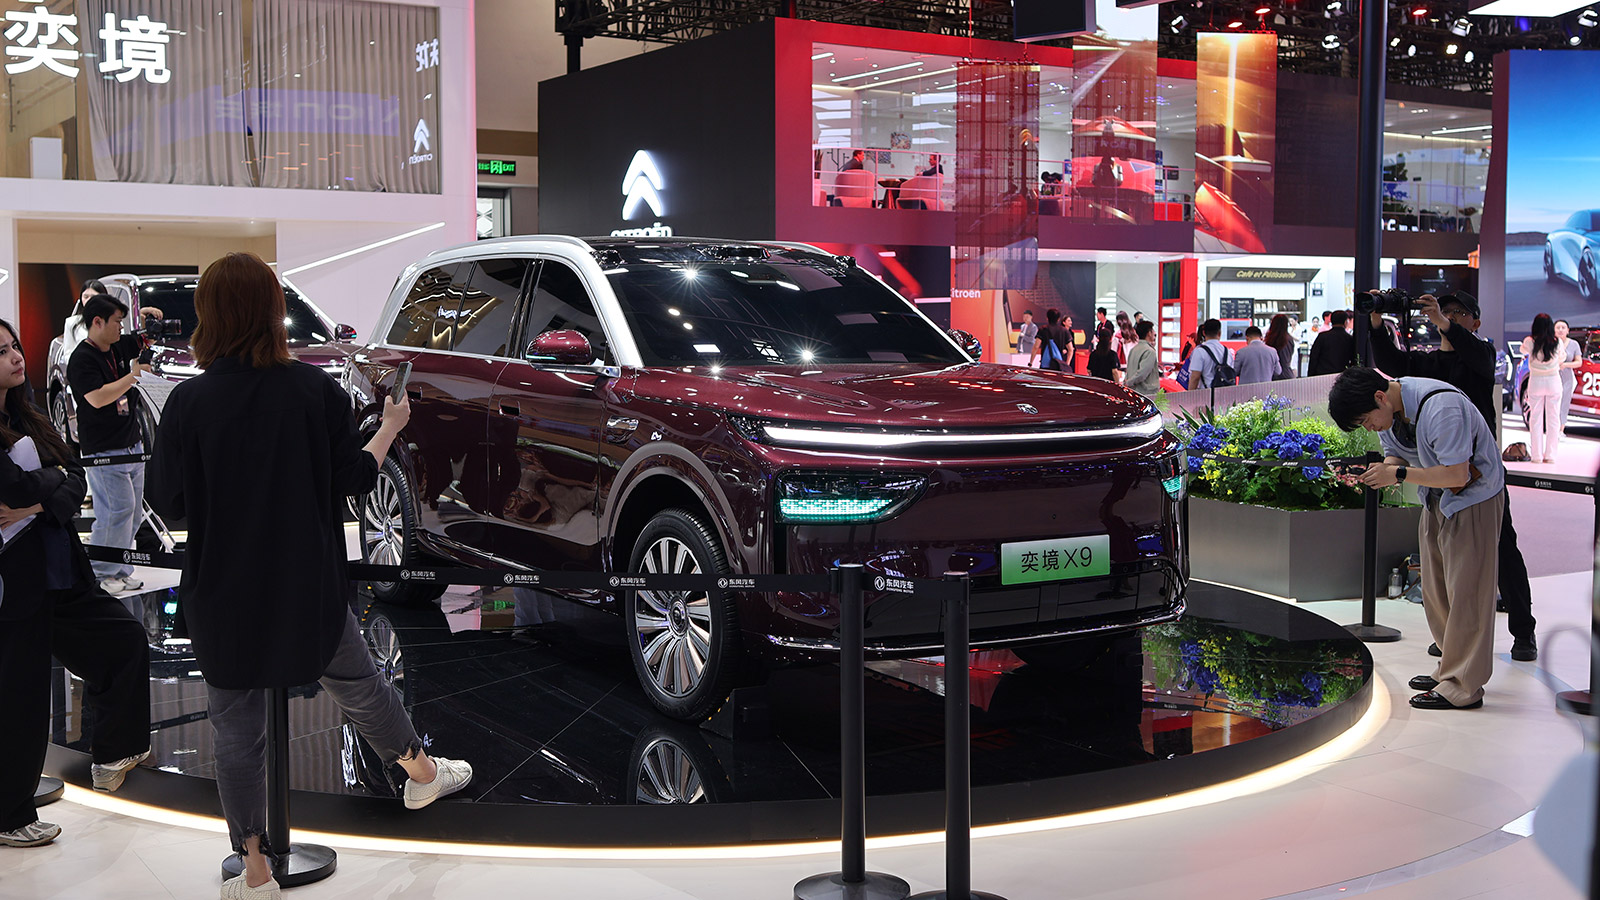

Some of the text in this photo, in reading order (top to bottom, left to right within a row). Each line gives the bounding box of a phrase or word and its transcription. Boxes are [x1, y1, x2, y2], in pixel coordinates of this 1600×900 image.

[4, 6, 172, 84] 奕境
[886, 578, 914, 589] 东风汽车
